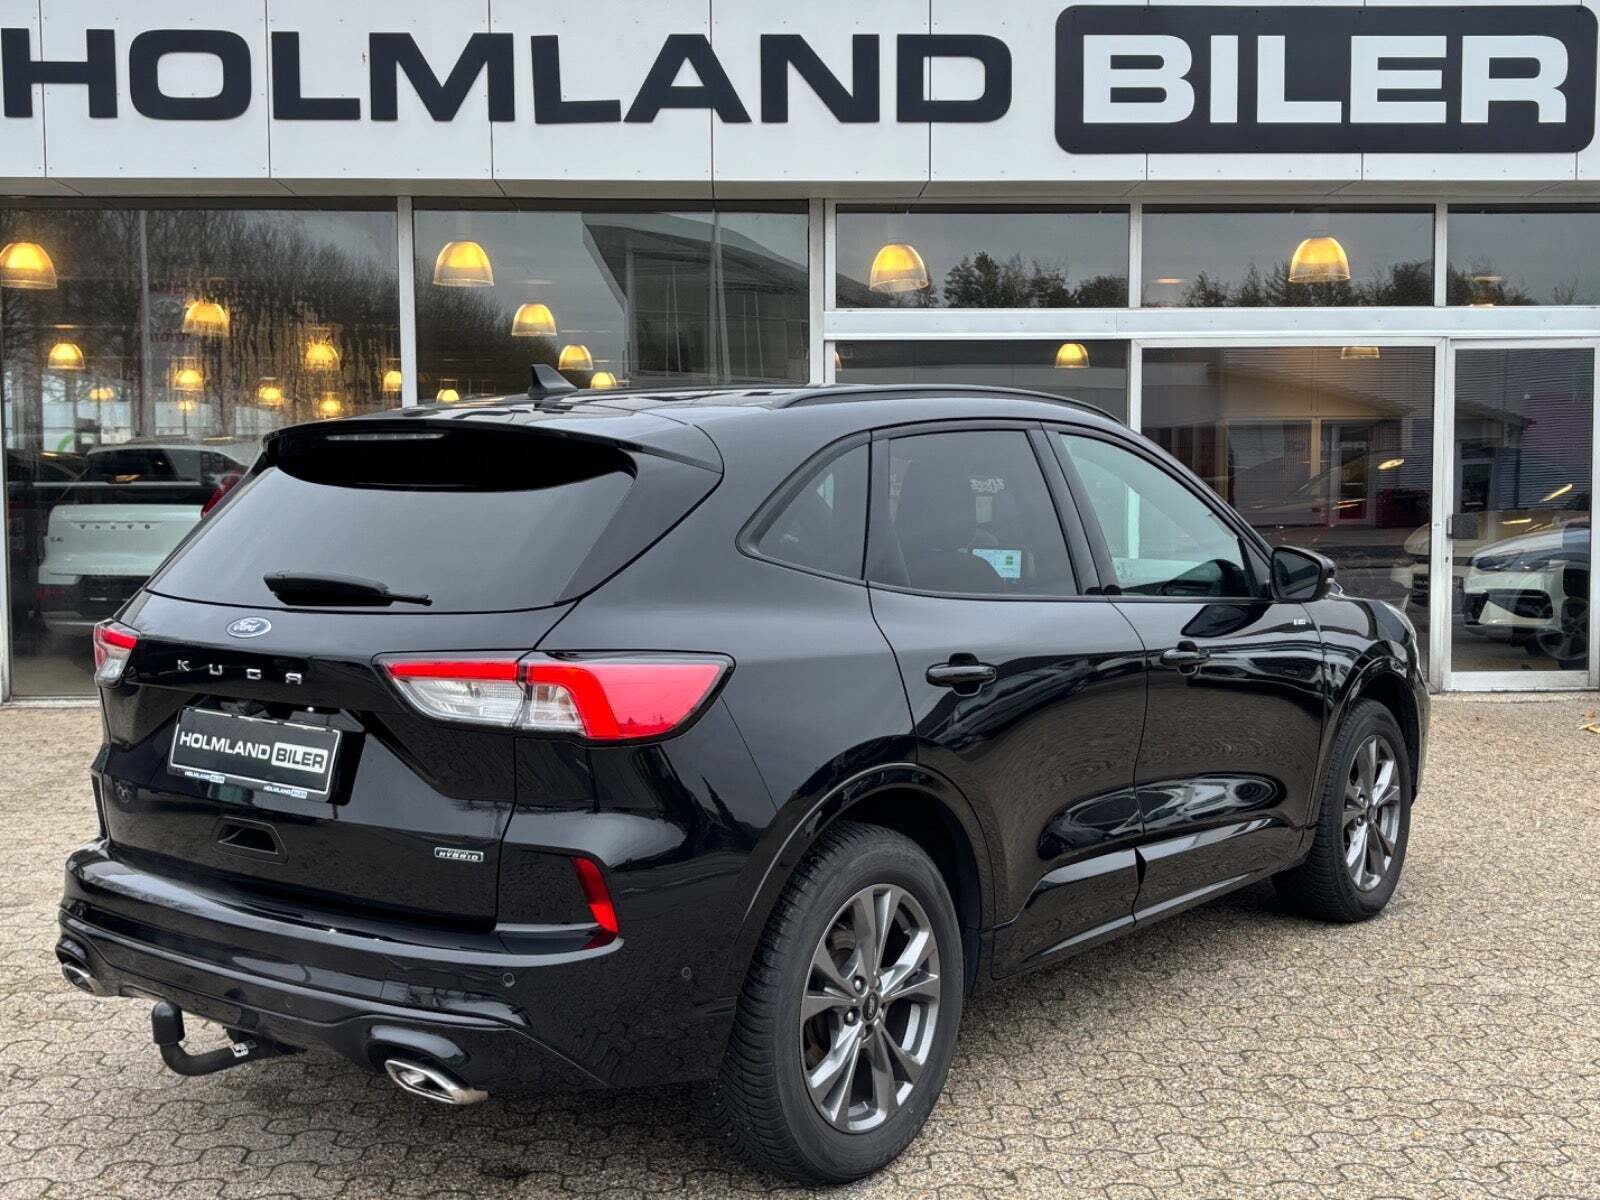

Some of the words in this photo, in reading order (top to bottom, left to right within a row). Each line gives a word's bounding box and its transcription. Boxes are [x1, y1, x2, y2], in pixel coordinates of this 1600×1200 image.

[1, 28, 1012, 124] HOLMLAND
[1083, 34, 1569, 123] BILER
[177, 659, 302, 685] KUGA
[179, 731, 271, 760] HOLMLAND
[275, 747, 326, 769] BILER
[263, 785, 292, 796] HOLMLAND
